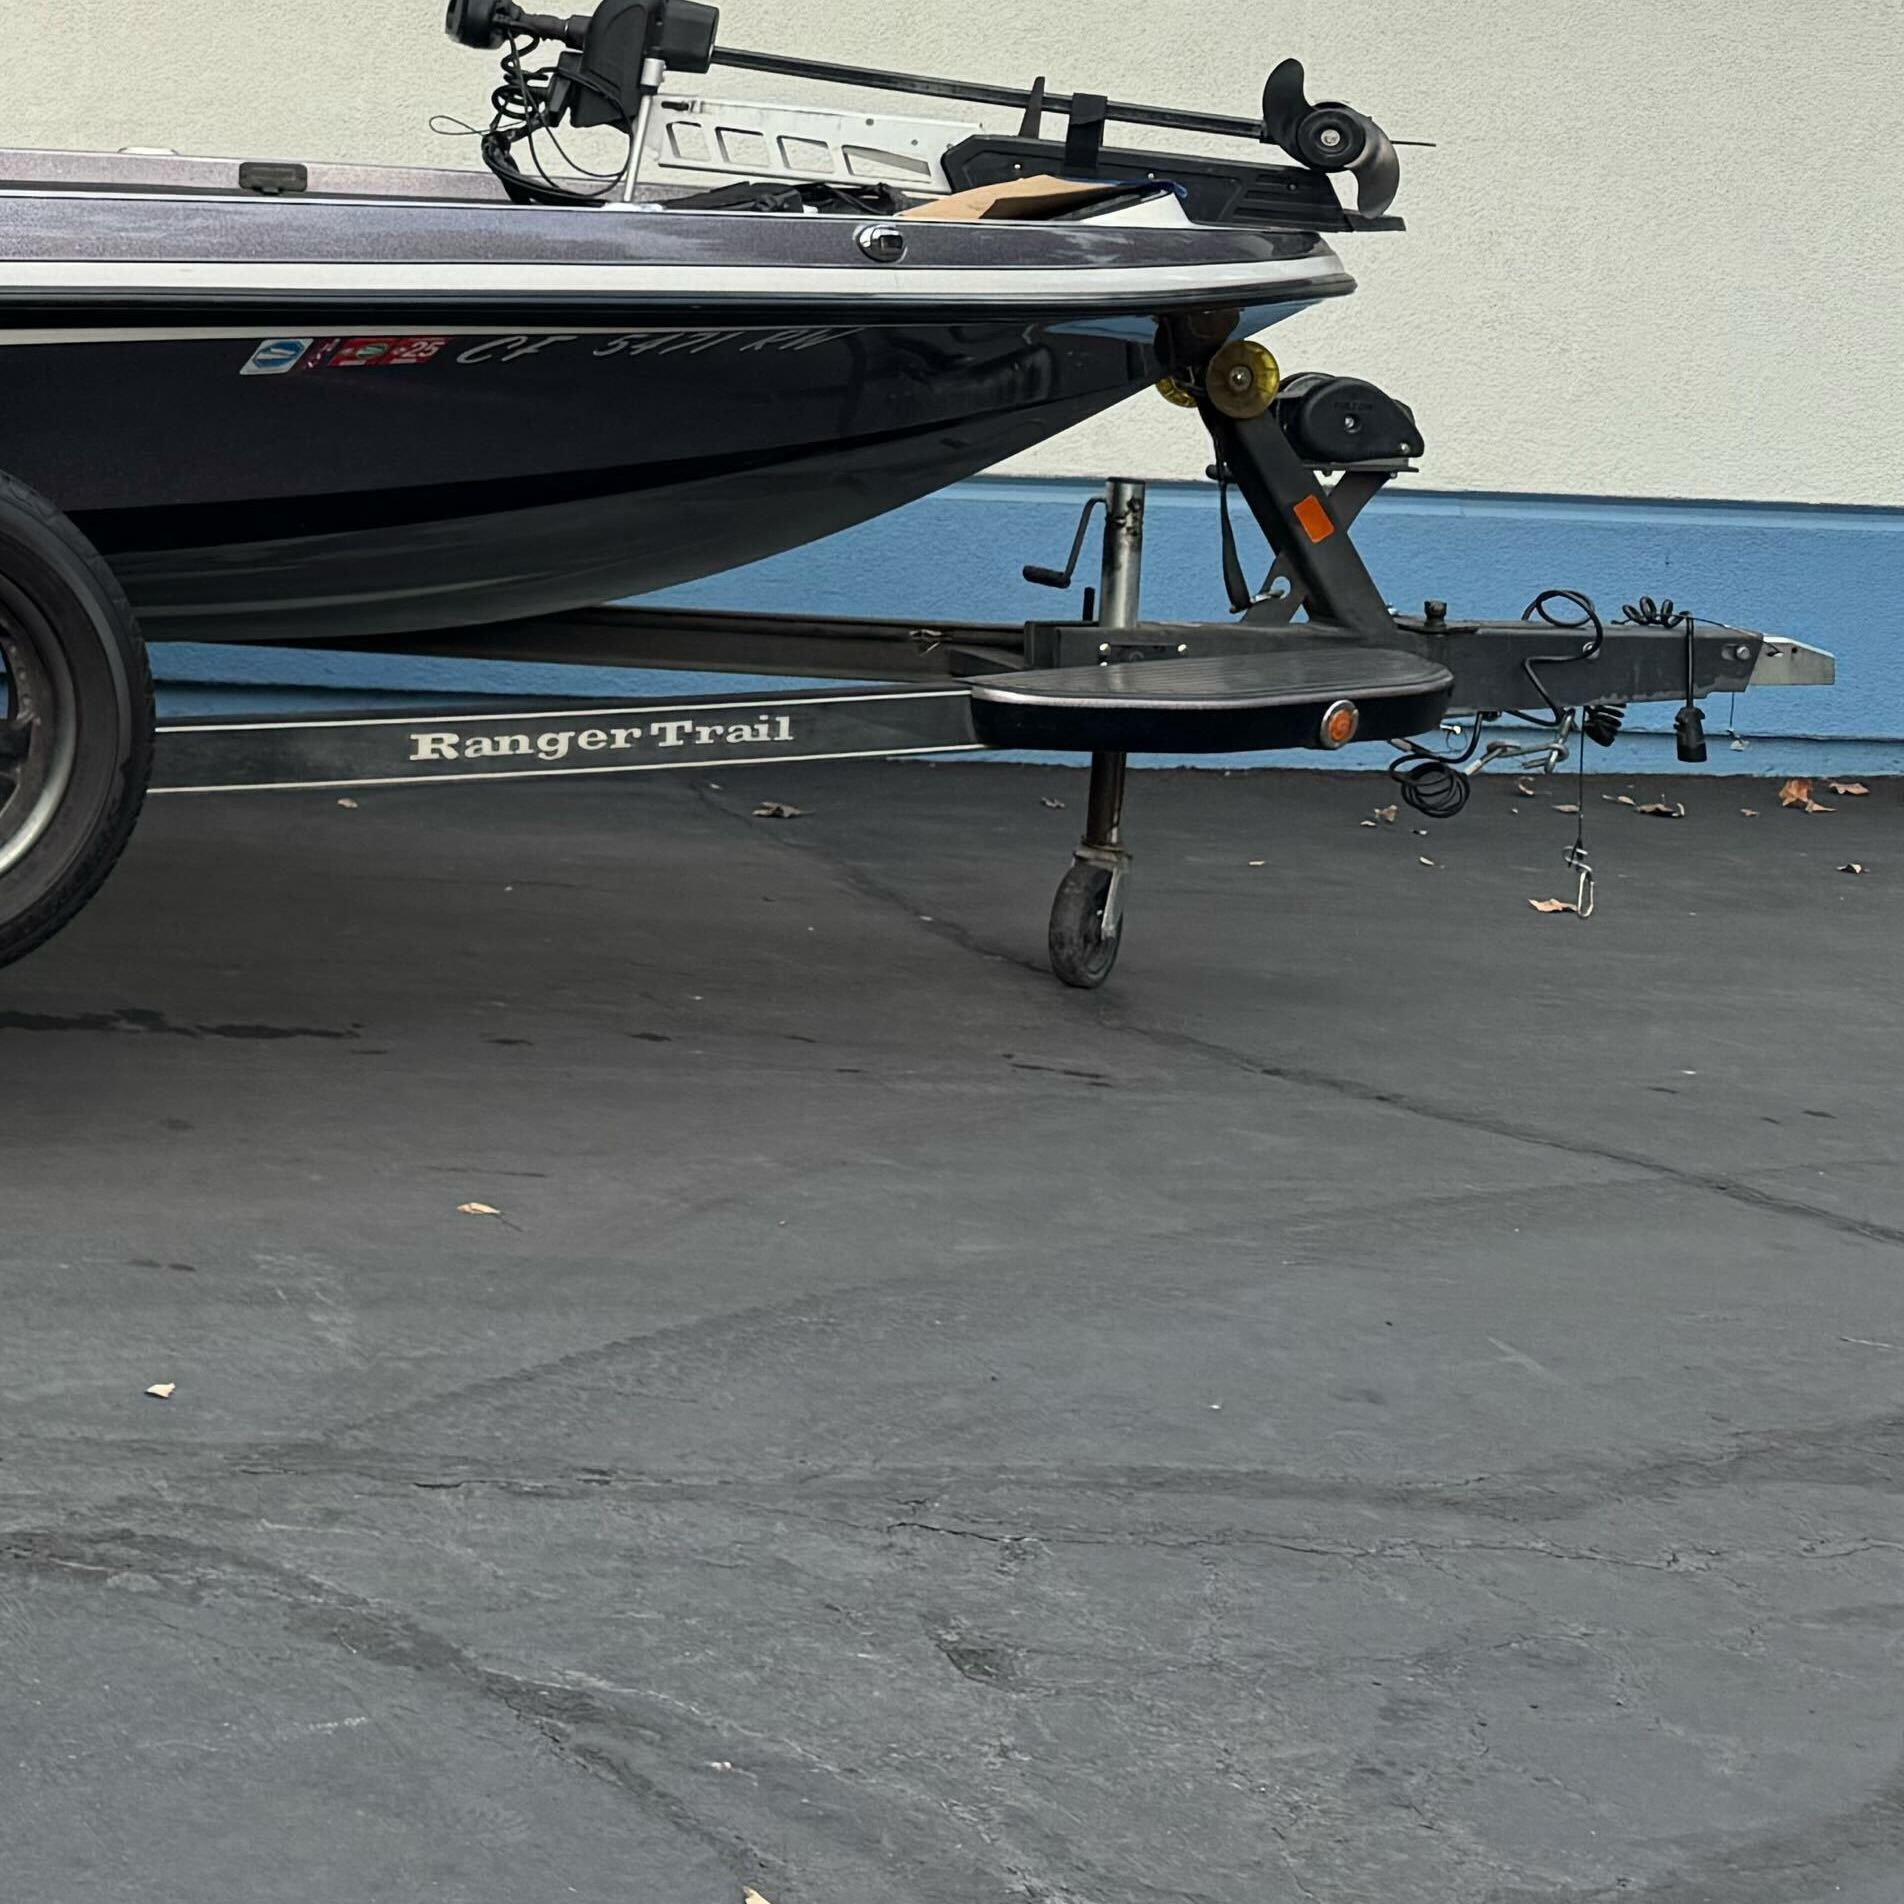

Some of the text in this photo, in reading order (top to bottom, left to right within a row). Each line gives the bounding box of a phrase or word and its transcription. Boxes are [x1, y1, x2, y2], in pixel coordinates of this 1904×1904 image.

[456, 334, 578, 364] CF
[408, 714, 794, 762] Ranger Trail
